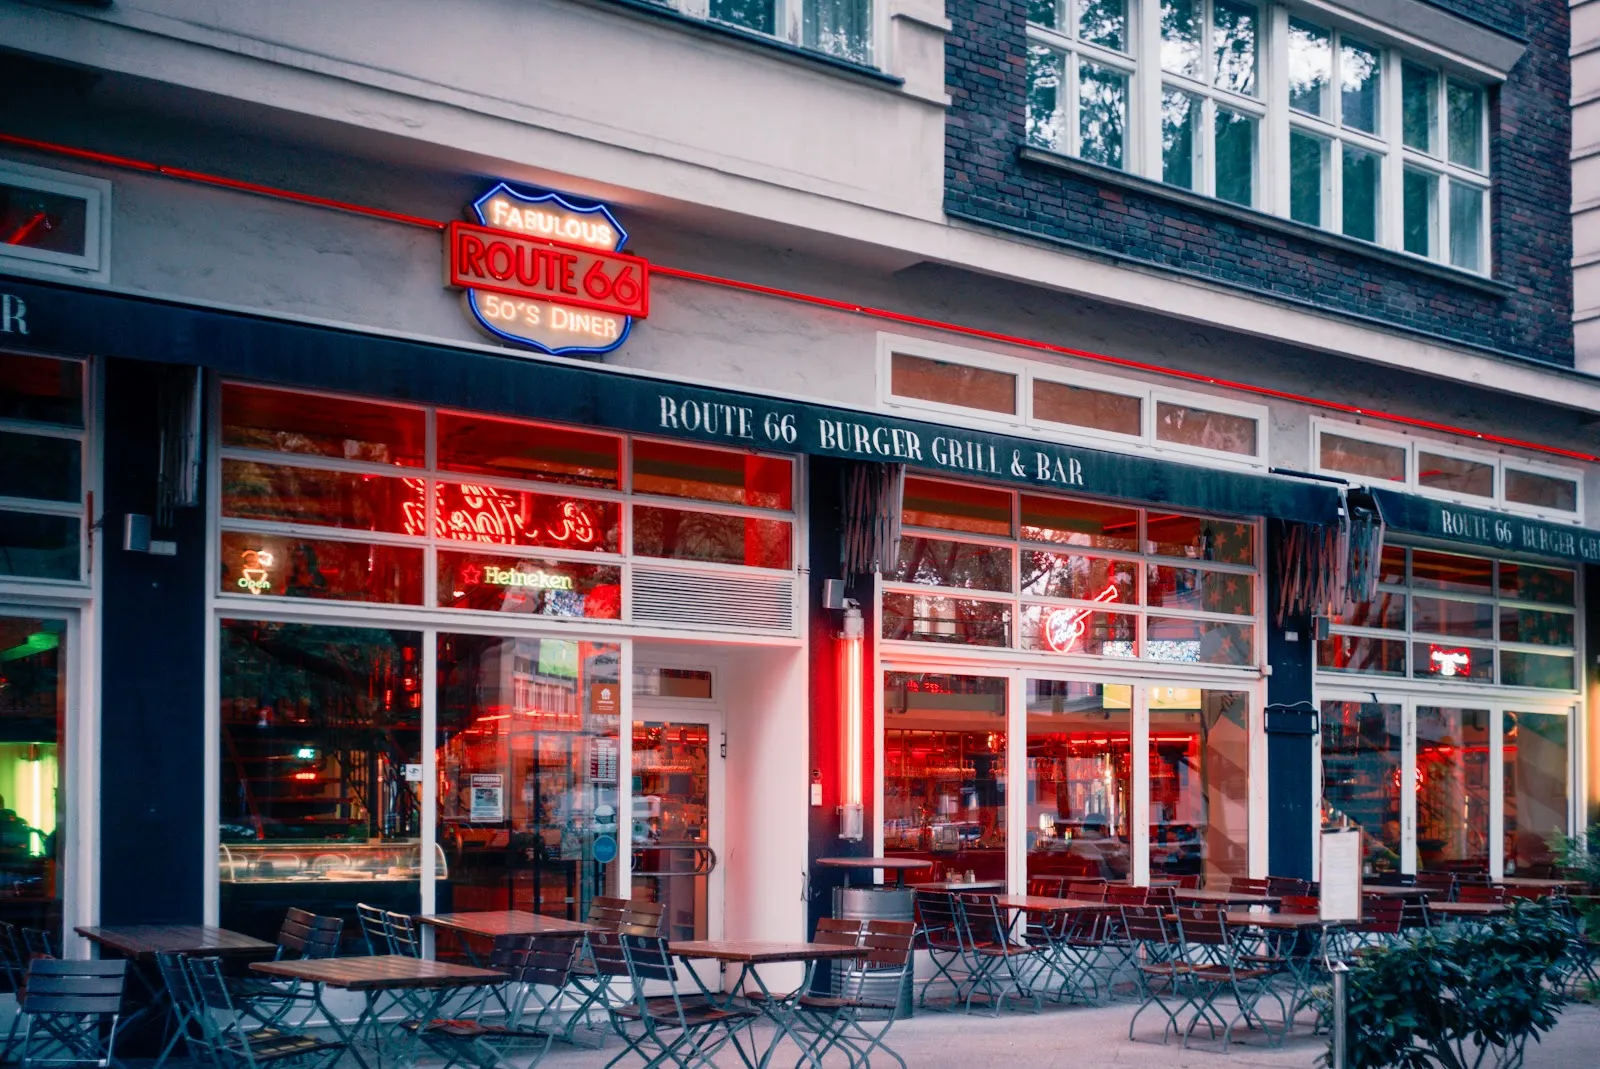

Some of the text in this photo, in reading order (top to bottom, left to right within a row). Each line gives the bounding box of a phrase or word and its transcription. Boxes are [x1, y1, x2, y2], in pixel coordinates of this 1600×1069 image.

[492, 200, 612, 245] FABULOUS
[459, 233, 641, 306] ROUTE 66
[484, 294, 618, 339] 50'S DINER
[658, 395, 1084, 486] ROUTE 66 BURGER GRILL & BAR
[1441, 509, 1490, 541] ROUTE
[1495, 519, 1513, 544] 66
[1522, 523, 1576, 556] BURGER
[238, 577, 271, 589] Open
[483, 565, 573, 590] Heineken
